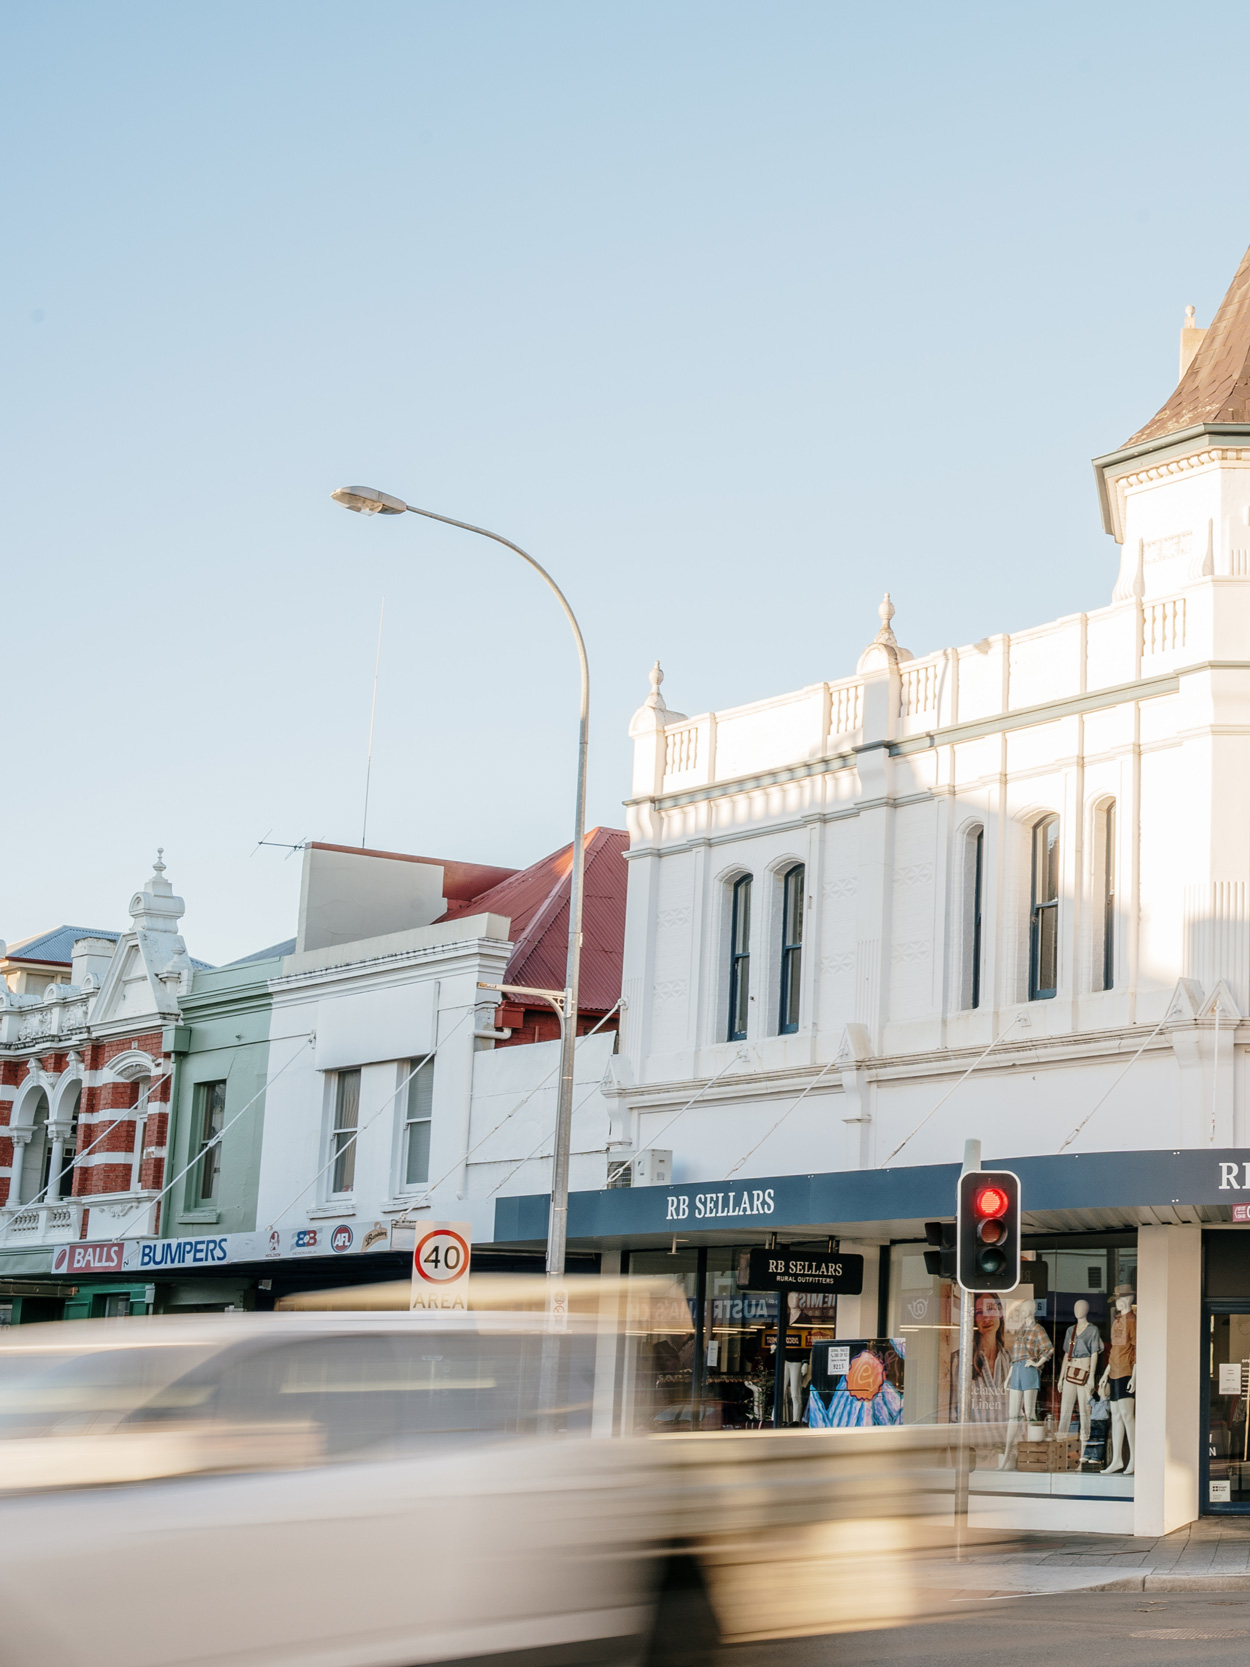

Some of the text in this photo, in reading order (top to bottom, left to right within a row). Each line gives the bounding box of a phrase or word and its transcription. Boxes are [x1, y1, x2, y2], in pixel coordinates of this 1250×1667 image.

[666, 1189, 775, 1219] RB SELLARS
[333, 1232, 350, 1247] AFL
[73, 1246, 119, 1268] BALLS
[140, 1238, 227, 1266] BUMPERS
[423, 1245, 461, 1270] 40
[768, 1260, 843, 1276] RB SELLARS
[798, 1276, 834, 1284] OUTFITTERS
[412, 1292, 465, 1309] AREA
[971, 1385, 1007, 1396] elaxed
[971, 1400, 1001, 1410] Linen
